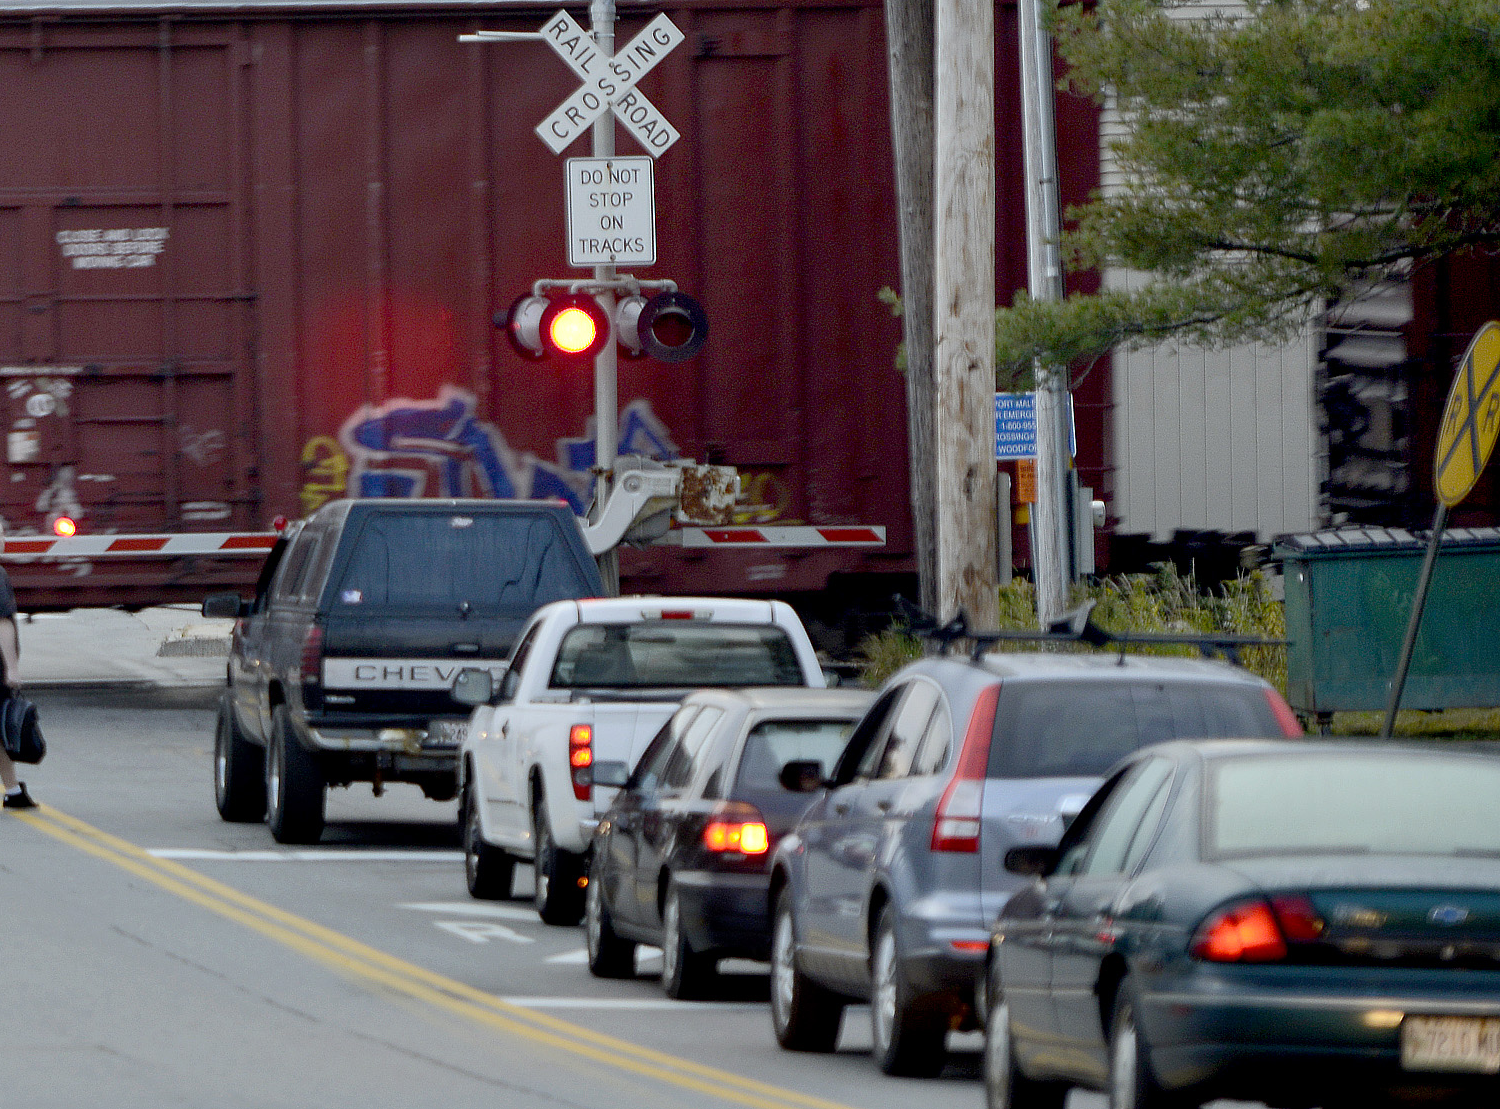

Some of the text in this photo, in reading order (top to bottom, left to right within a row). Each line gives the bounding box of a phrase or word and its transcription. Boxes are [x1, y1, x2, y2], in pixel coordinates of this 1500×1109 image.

[548, 17, 596, 74] RAIL
[551, 27, 671, 139] CROSSING
[617, 92, 670, 148] ROAD
[581, 168, 641, 185] DO NOT
[589, 192, 633, 208] STOP
[600, 215, 623, 230] ON
[579, 237, 644, 253] TRACKS
[996, 399, 1013, 408] ORT
